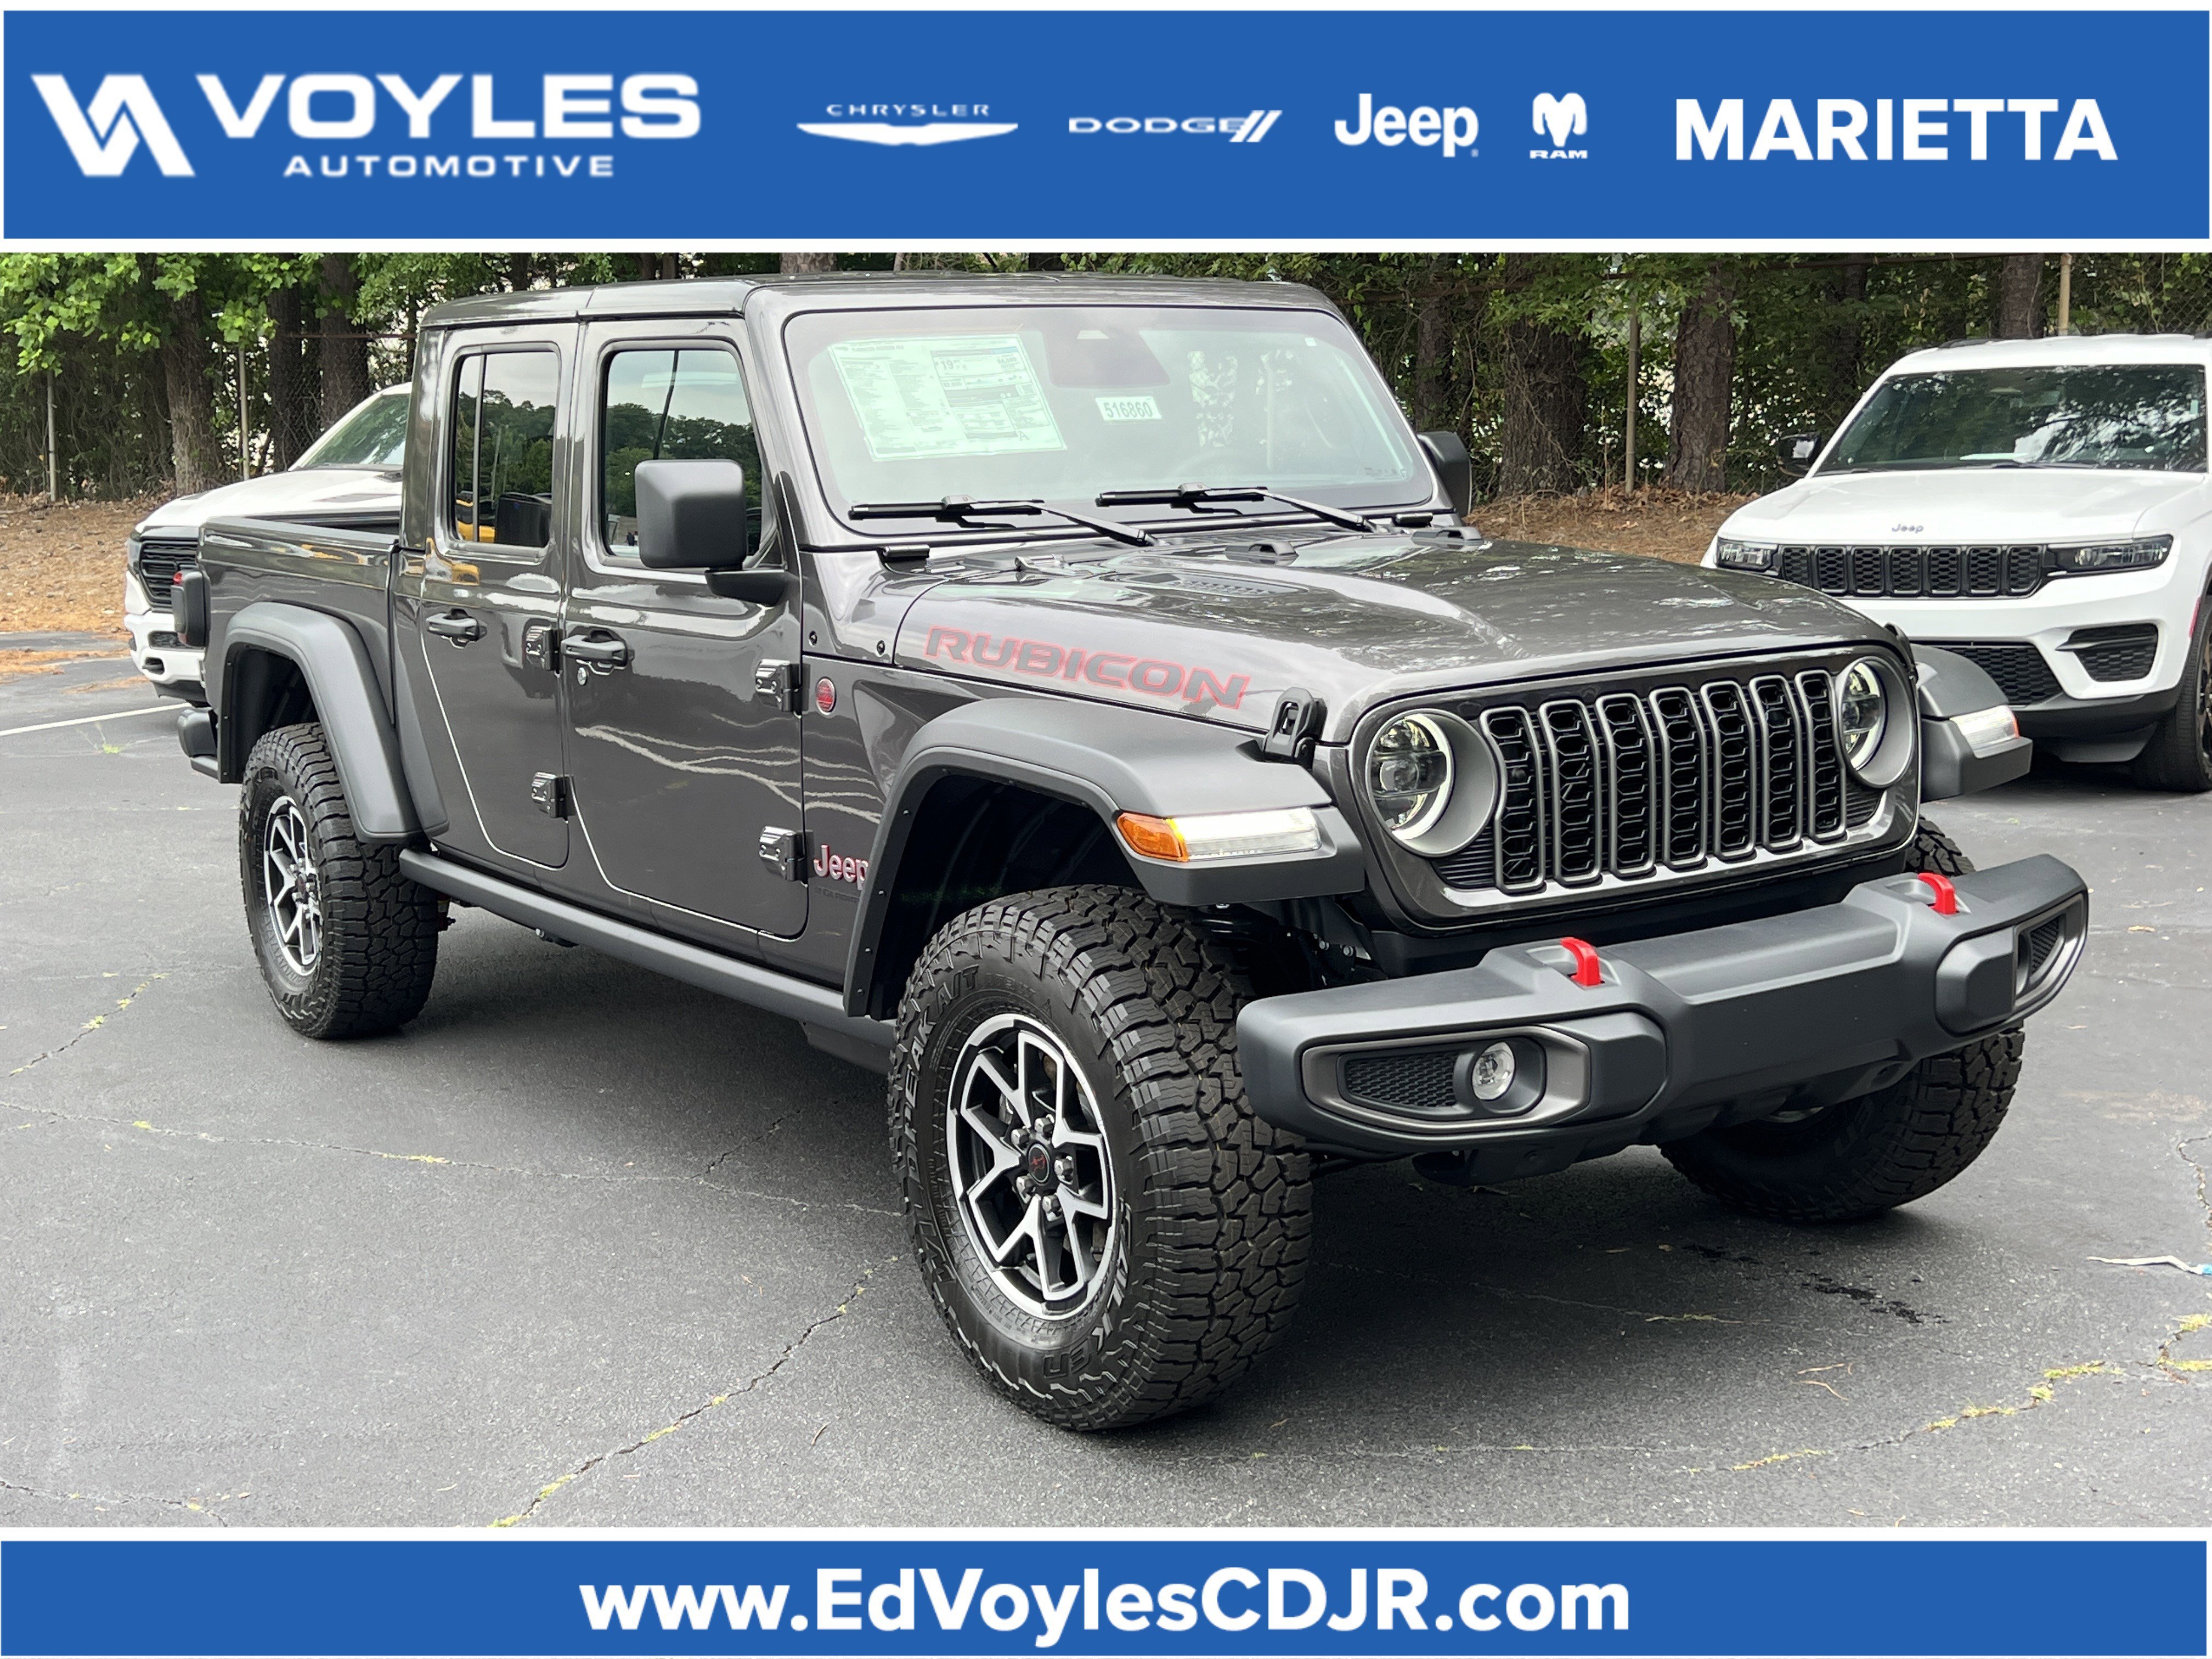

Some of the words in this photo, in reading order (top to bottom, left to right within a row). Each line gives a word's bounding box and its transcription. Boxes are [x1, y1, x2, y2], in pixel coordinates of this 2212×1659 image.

[1103, 402, 1153, 419] 516860
[1891, 523, 1923, 534] Jeep
[925, 625, 1251, 710] RUBICON
[813, 844, 869, 890] Jeep
